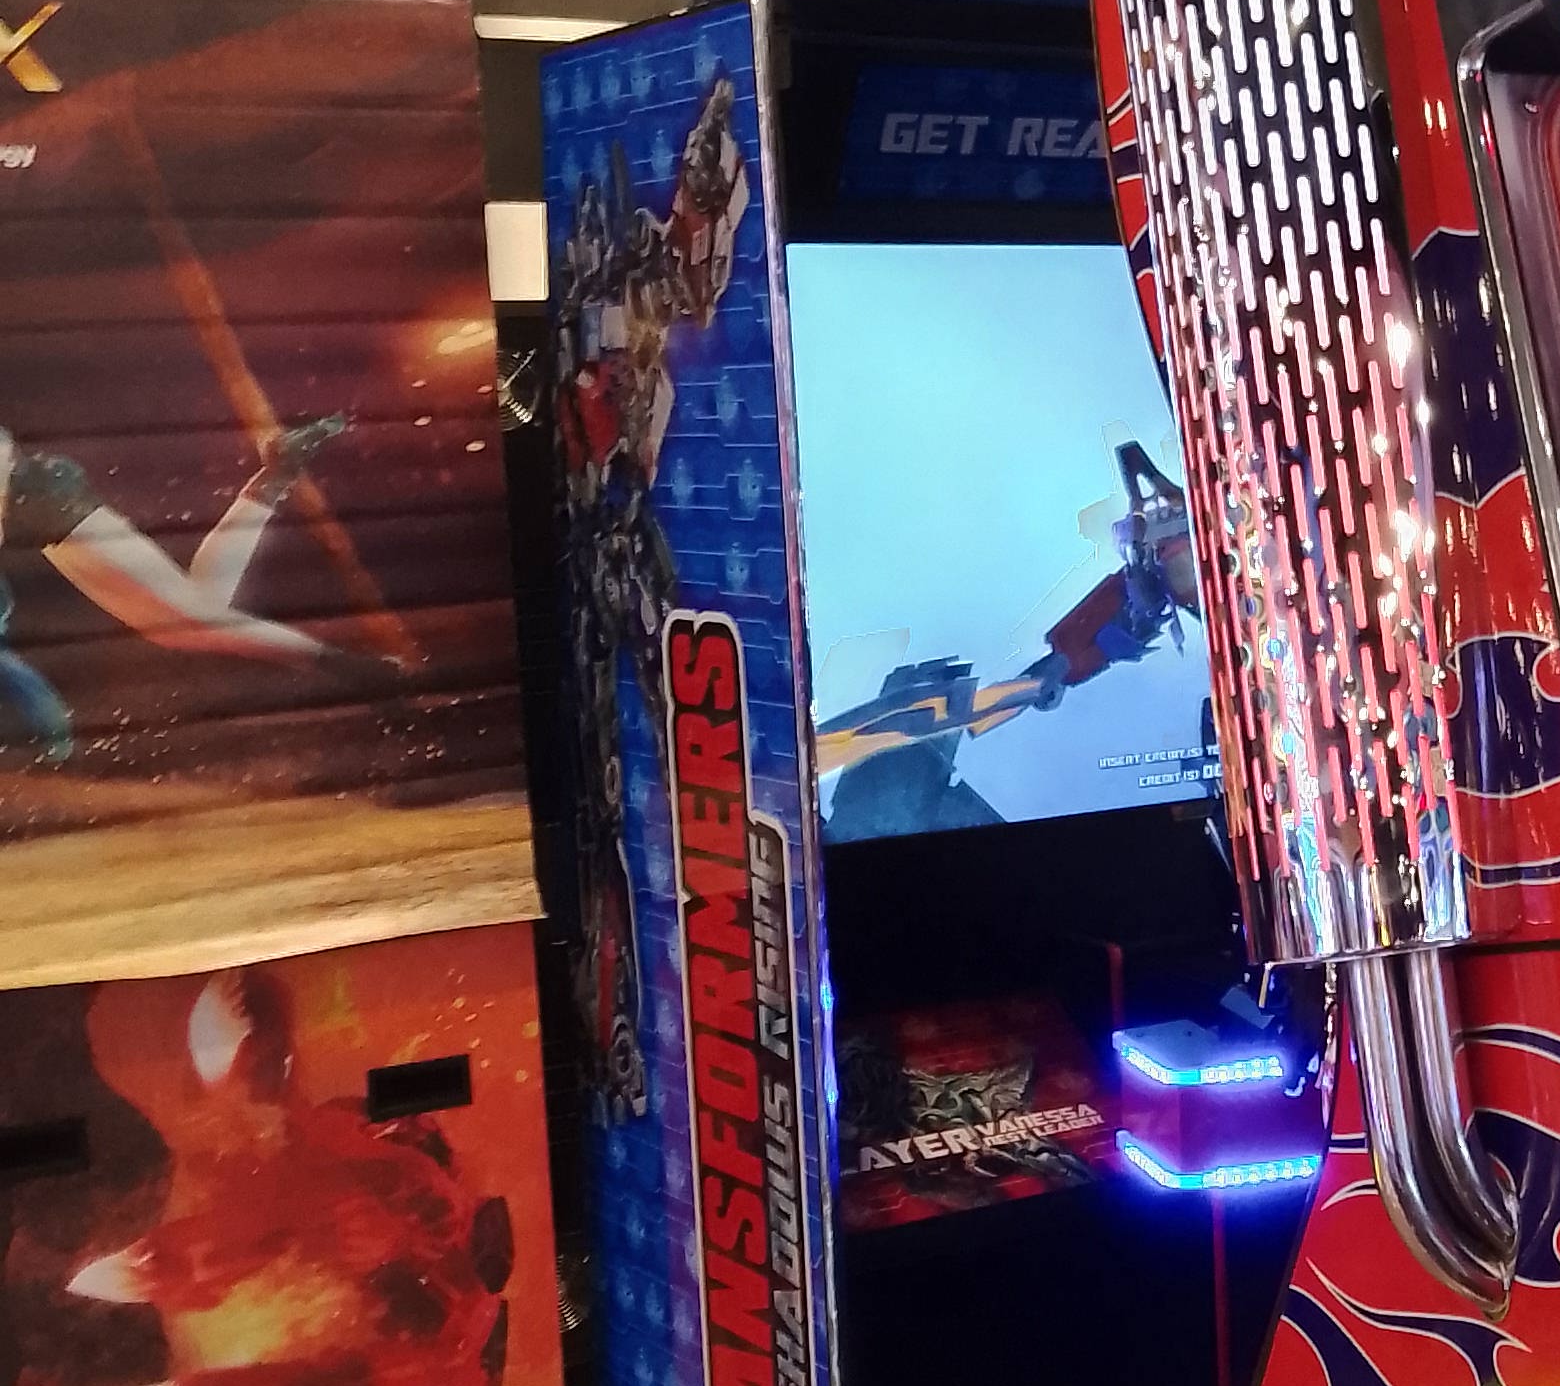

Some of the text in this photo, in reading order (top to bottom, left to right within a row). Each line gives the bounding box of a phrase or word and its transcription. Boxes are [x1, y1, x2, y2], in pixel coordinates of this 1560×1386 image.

[879, 112, 989, 154] GET
[1098, 753, 1141, 768] INSERT
[749, 829, 791, 1061] RISING
[974, 1103, 1098, 1136] VANESSA
[1032, 1114, 1104, 1138] LEADER
